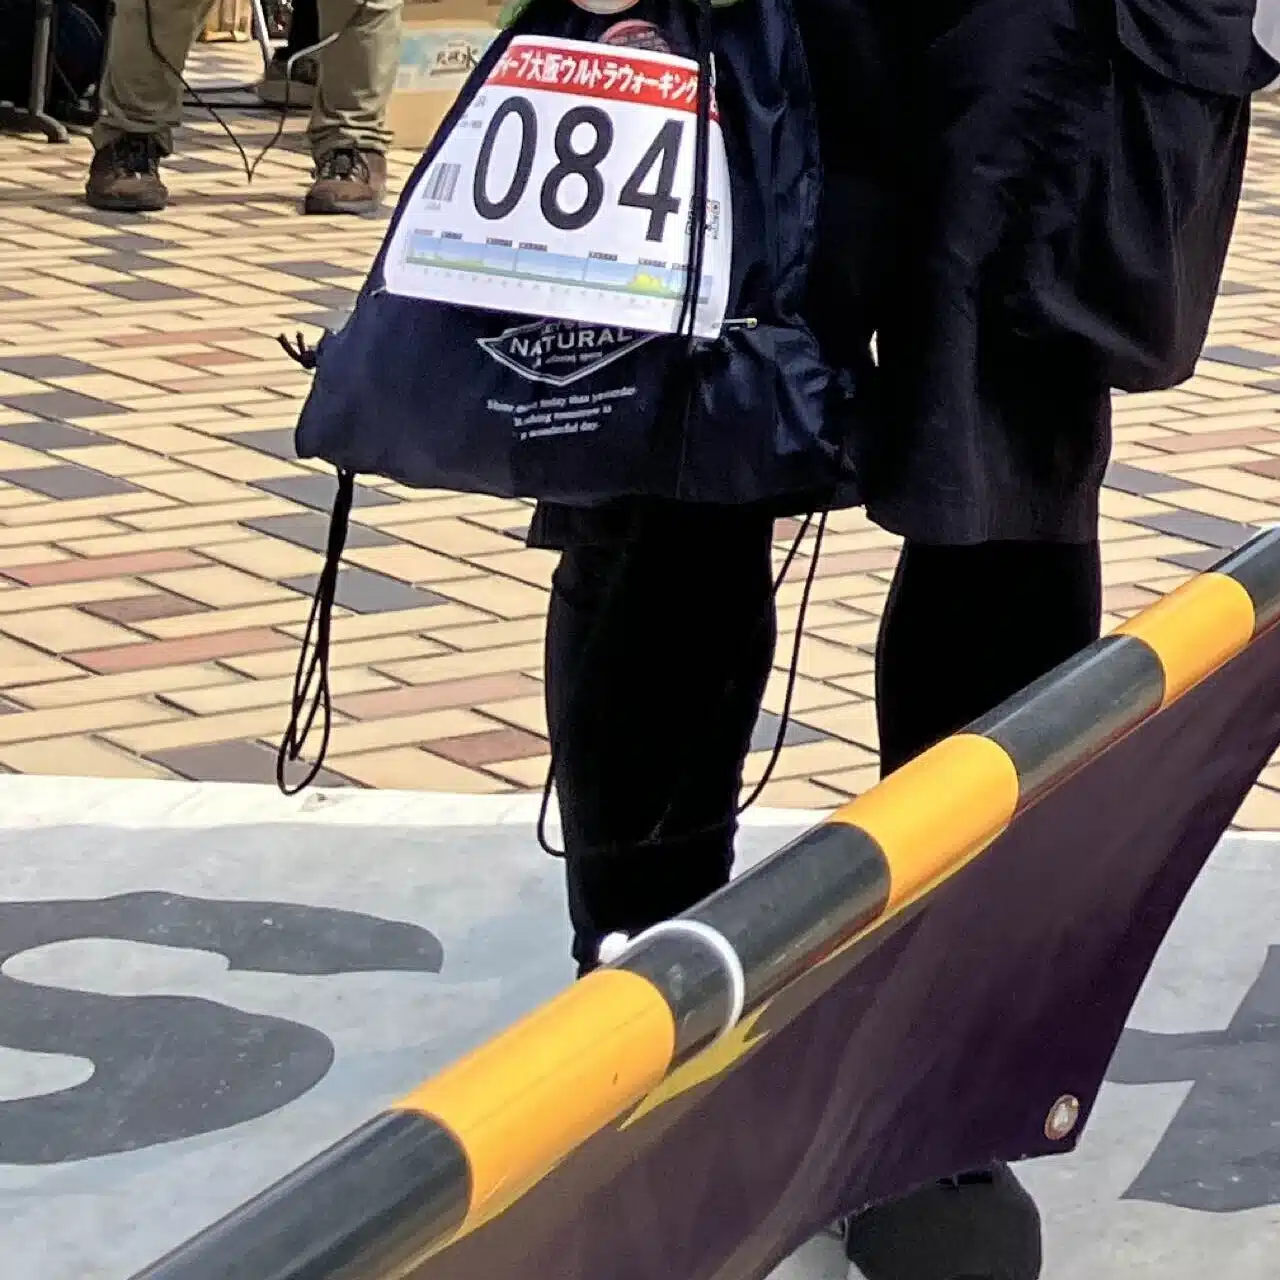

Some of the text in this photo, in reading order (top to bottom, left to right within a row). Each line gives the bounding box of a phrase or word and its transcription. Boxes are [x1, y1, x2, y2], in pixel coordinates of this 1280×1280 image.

[491, 49, 698, 104] ィープ大阪ウルトラウォーキング
[473, 95, 686, 244] 084
[509, 327, 633, 357] NATURAL
